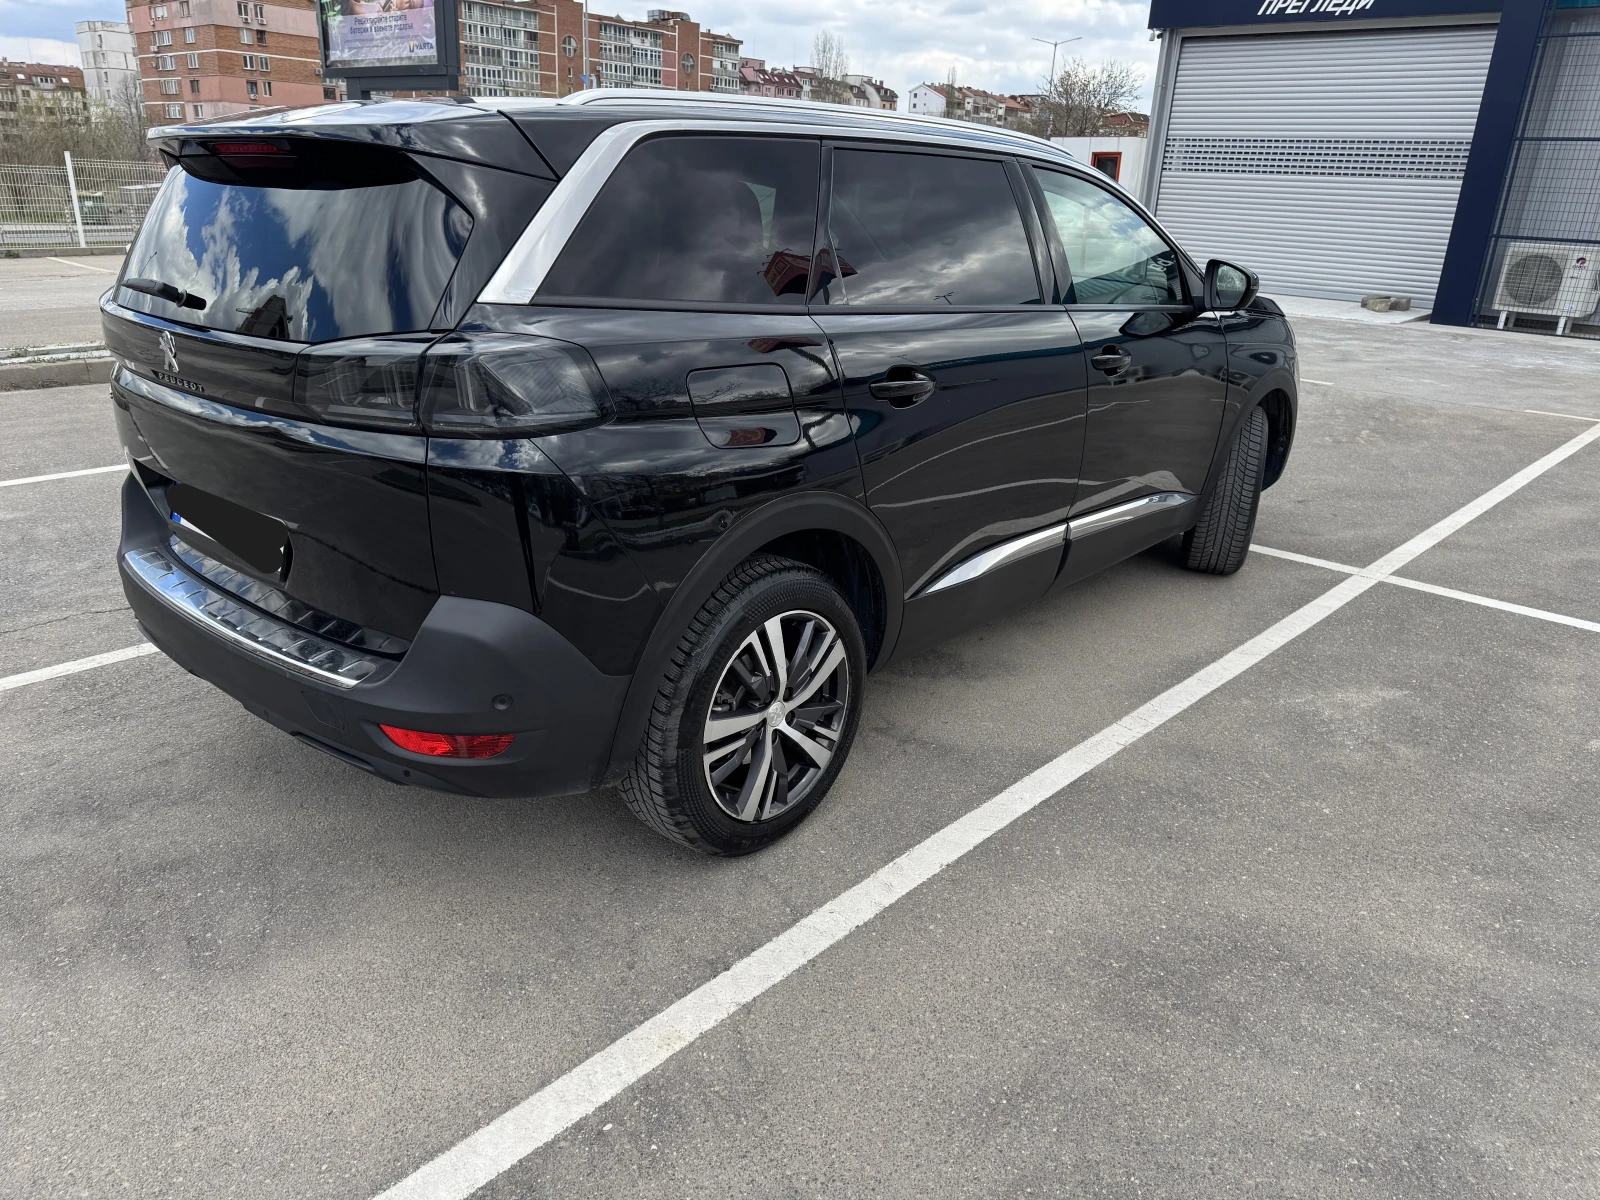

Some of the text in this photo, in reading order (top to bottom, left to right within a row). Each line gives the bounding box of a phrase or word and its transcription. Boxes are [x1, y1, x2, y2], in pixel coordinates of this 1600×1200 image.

[1256, 0, 1375, 16] ПРЕГЛЕДИ
[415, 42, 434, 51] VARTA
[158, 372, 204, 392] PEUGEOT
